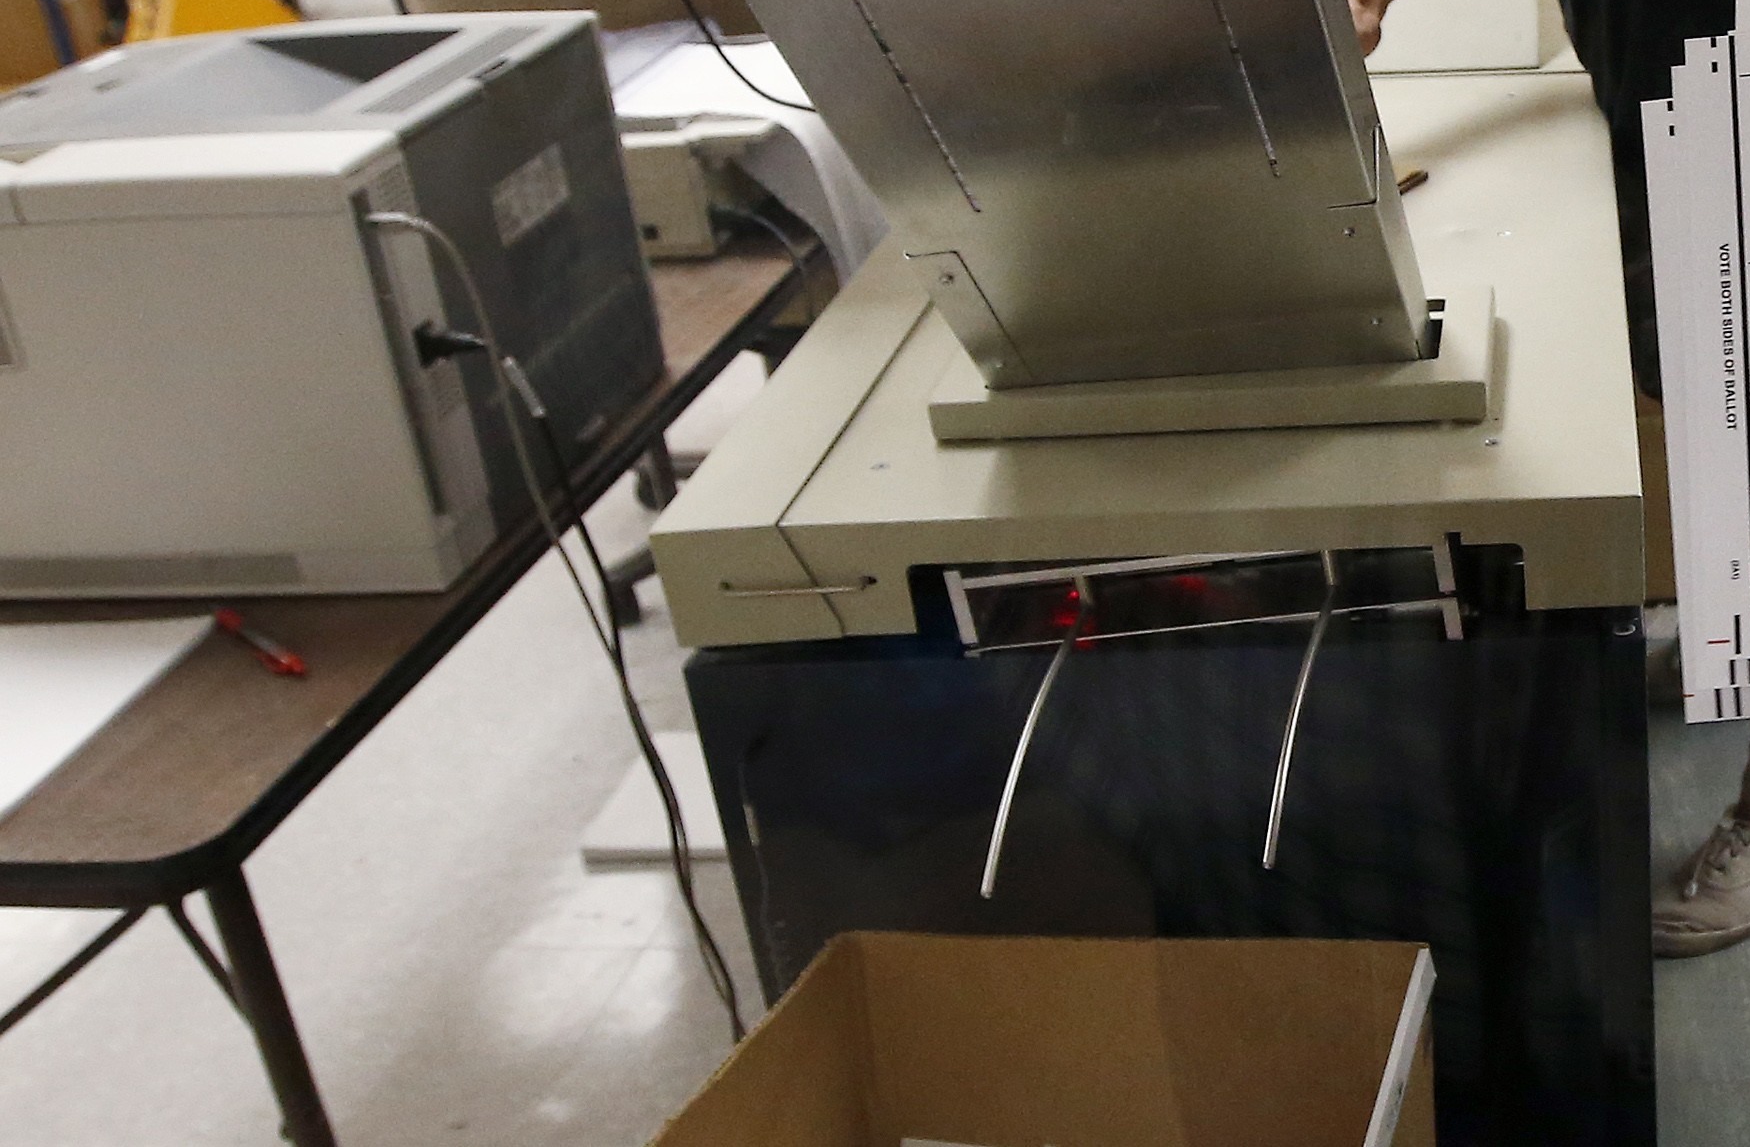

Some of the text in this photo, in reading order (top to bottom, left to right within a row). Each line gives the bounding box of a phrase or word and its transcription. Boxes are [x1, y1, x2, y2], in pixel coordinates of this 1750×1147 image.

[1718, 243, 1736, 431] VOTE BOTH SIDES OF BALLOT
